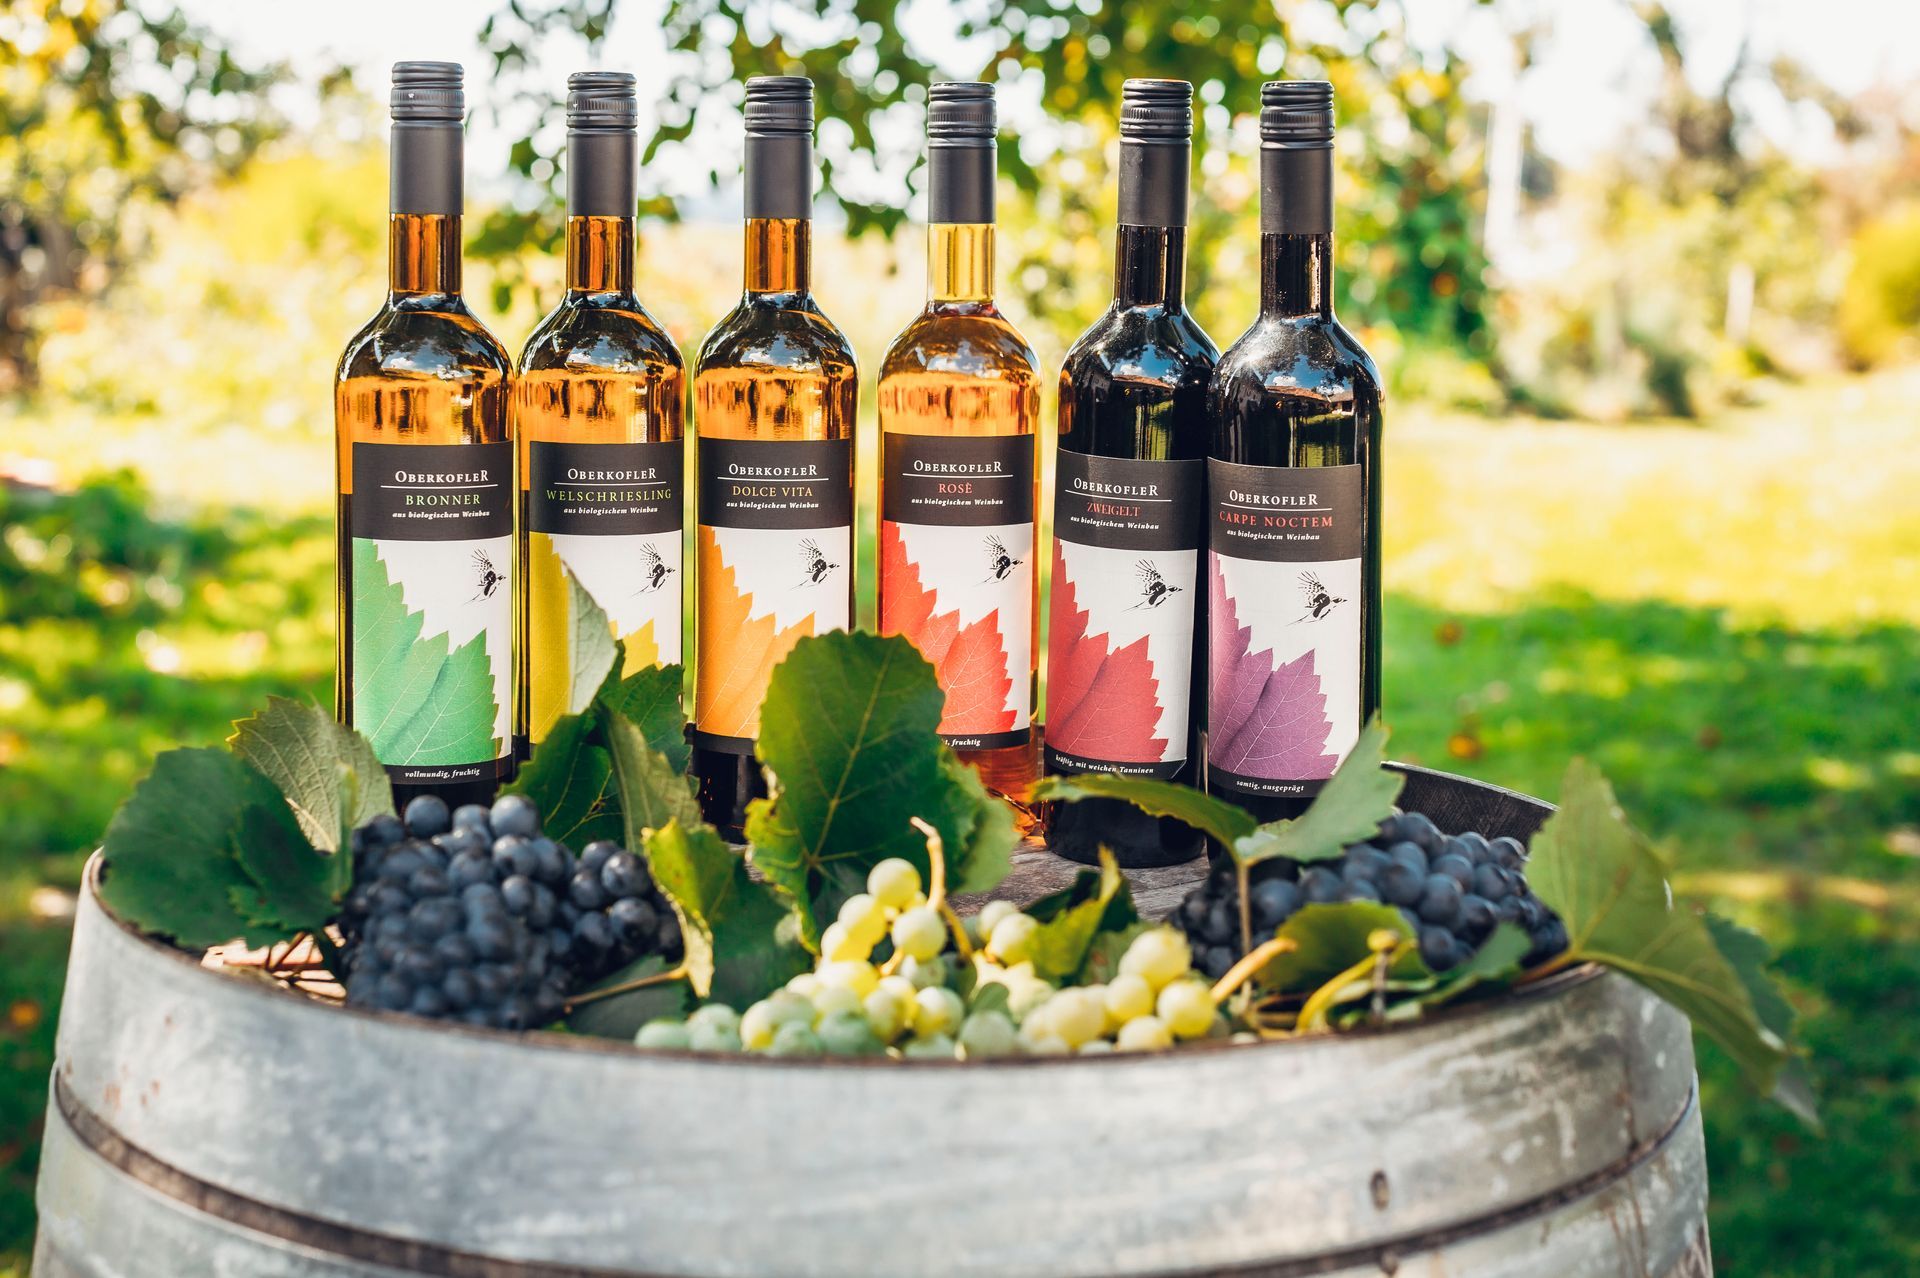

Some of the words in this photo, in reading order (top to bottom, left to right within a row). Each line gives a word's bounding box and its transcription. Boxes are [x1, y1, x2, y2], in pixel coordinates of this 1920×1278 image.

[546, 488, 672, 502] WELSCHRIESLING
[732, 485, 777, 497] DOLCE
[781, 487, 813, 497] VITA
[405, 494, 481, 506] BRONNER
[739, 501, 787, 510] biologischem
[924, 498, 972, 506] biologischem
[408, 510, 460, 520] biologischem
[578, 506, 627, 516] biologischem
[630, 506, 658, 514] Weinbau
[1087, 501, 1141, 517] ZWEIGELT
[1070, 515, 1080, 523] aus
[1080, 516, 1124, 529] biologischem
[1127, 522, 1160, 530] Weinbau
[1219, 510, 1257, 526] CARPE
[1264, 516, 1333, 528] NOCTEM
[1237, 529, 1283, 541] biologischem
[1286, 533, 1320, 541] Weinbau
[951, 738, 981, 747] fruchtig
[404, 770, 450, 779] vollmundig,
[451, 768, 480, 779] fruchtig
[1075, 761, 1087, 769] mit
[1088, 763, 1117, 773] weichen
[1119, 766, 1154, 774] Tanninen
[1236, 780, 1261, 790] samtig,
[1262, 783, 1305, 793] ausgeprägt
